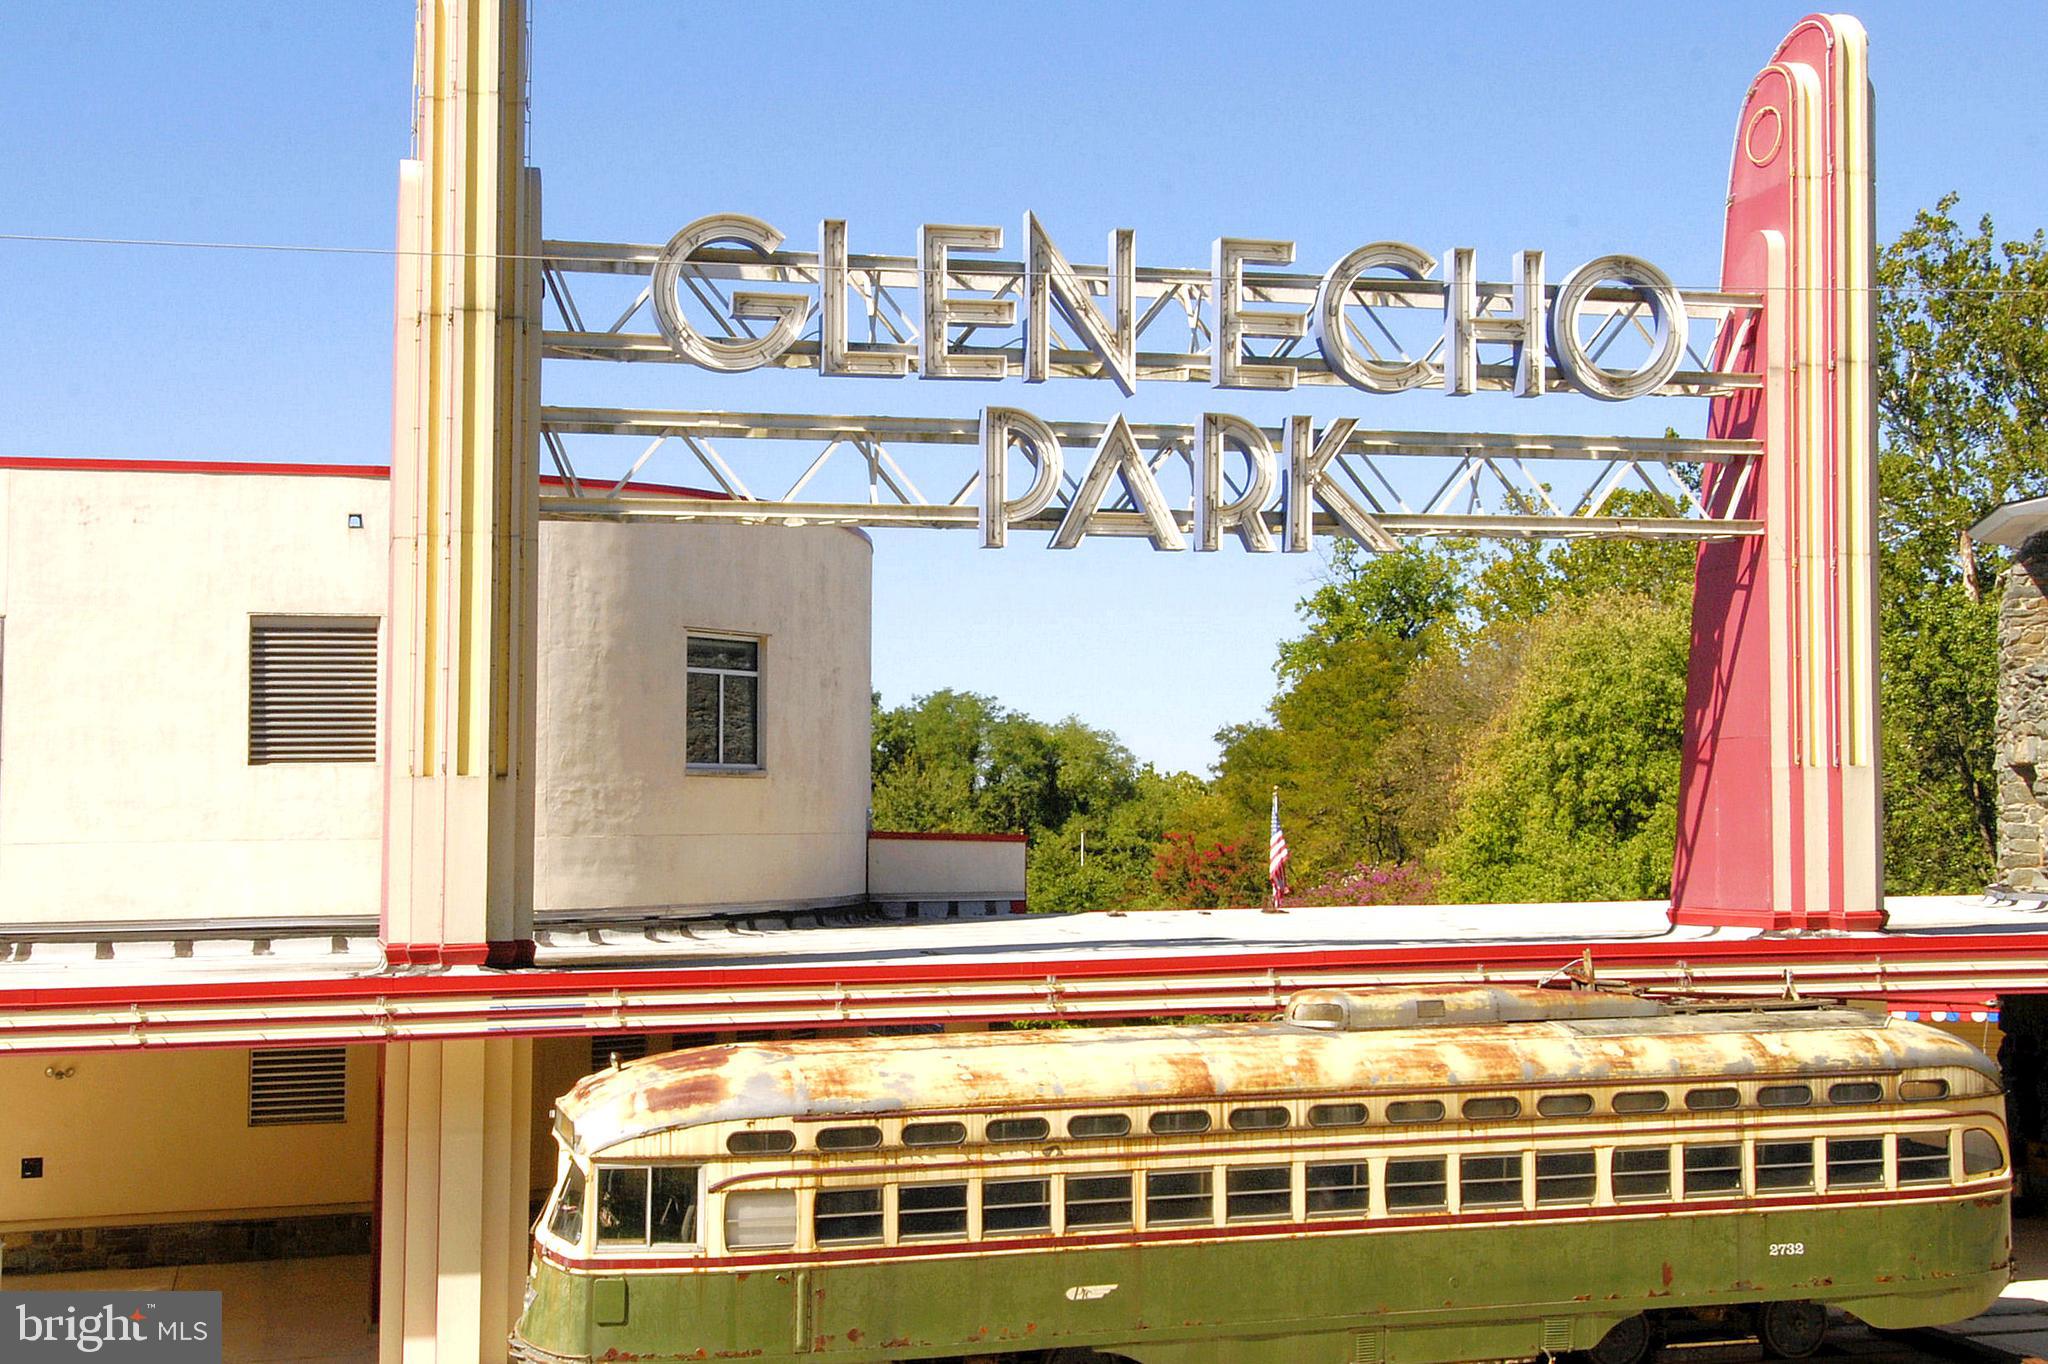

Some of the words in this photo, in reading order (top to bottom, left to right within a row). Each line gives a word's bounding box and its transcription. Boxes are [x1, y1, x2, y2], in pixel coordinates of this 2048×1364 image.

[651, 209, 1136, 397] GLEN
[1211, 237, 1689, 402] ECHO
[979, 405, 1402, 553] PARK
[1769, 1242, 1805, 1256] 2732
